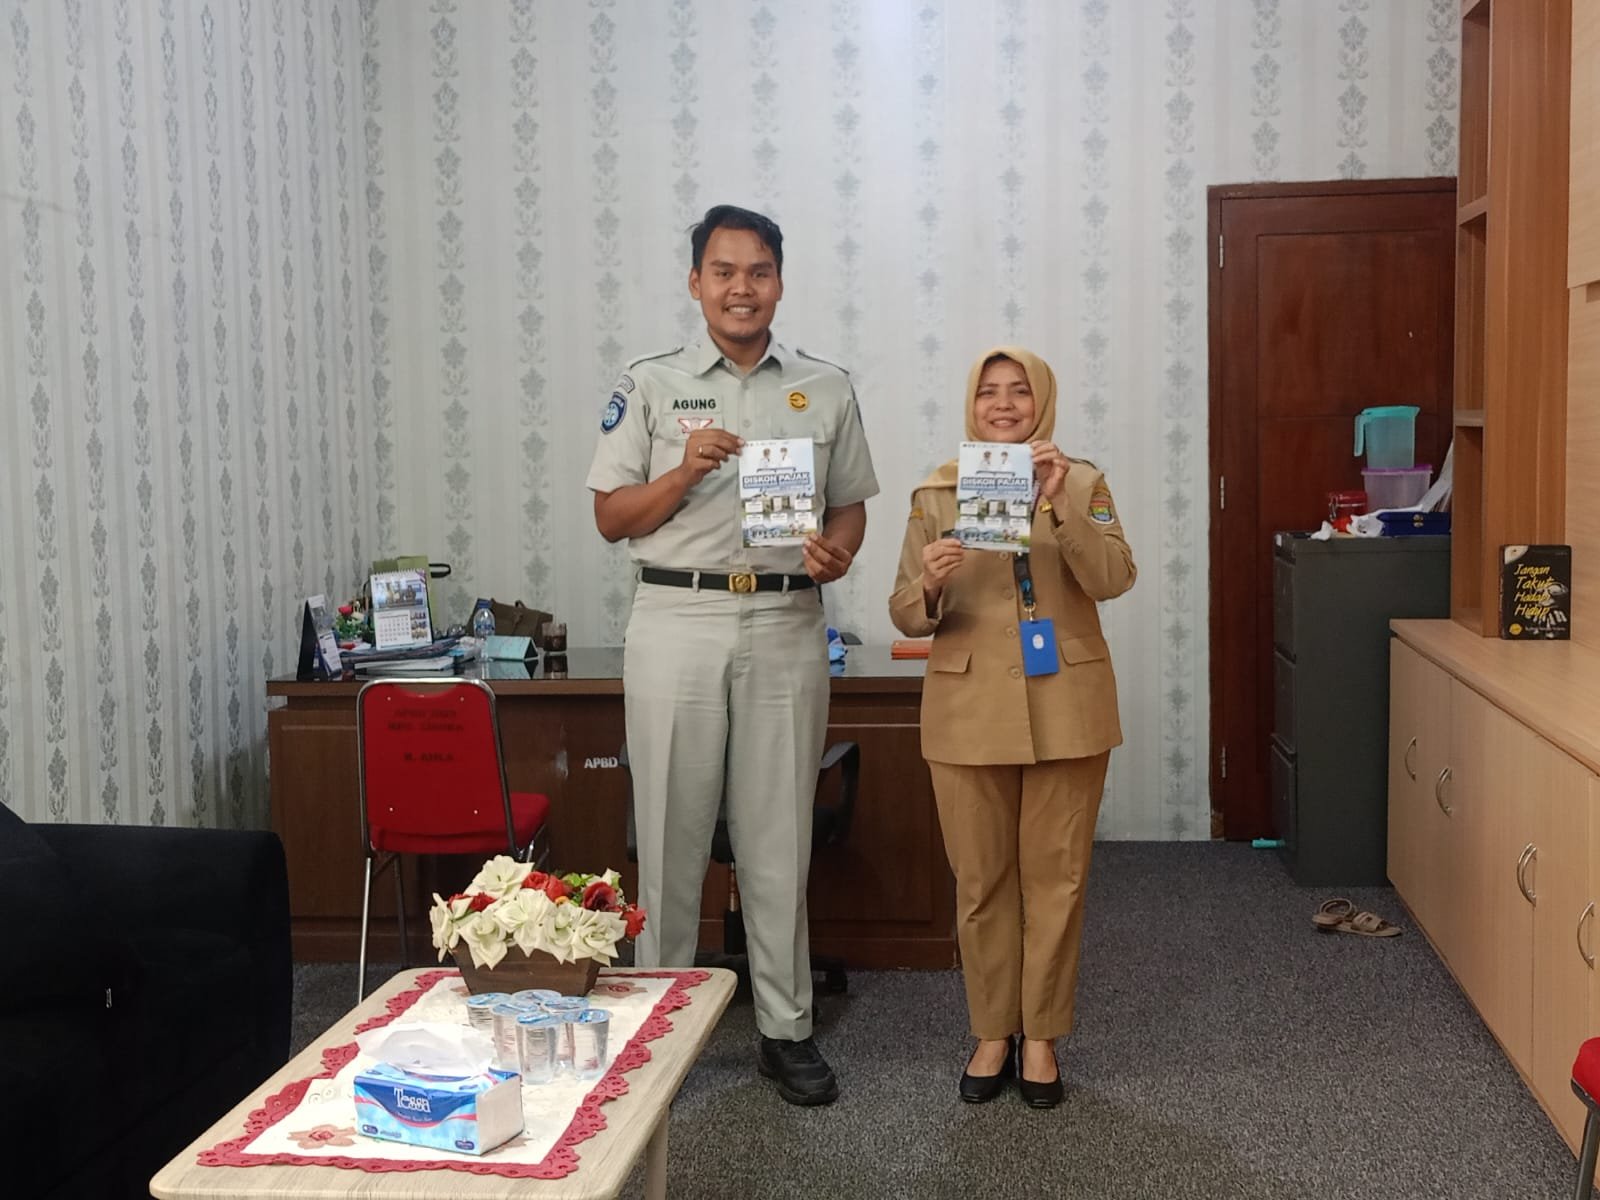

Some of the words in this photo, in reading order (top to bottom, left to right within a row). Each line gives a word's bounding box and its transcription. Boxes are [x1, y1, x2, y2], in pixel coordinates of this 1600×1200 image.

[672, 398, 717, 410] AGUNG
[743, 474, 777, 484] DISKON
[779, 472, 809, 482] PAJAK
[997, 478, 1027, 487] PAJAK
[1514, 564, 1550, 577] Jangan
[1516, 576, 1555, 590] Takut
[1513, 604, 1551, 618] Hidup
[584, 756, 618, 769] APBD
